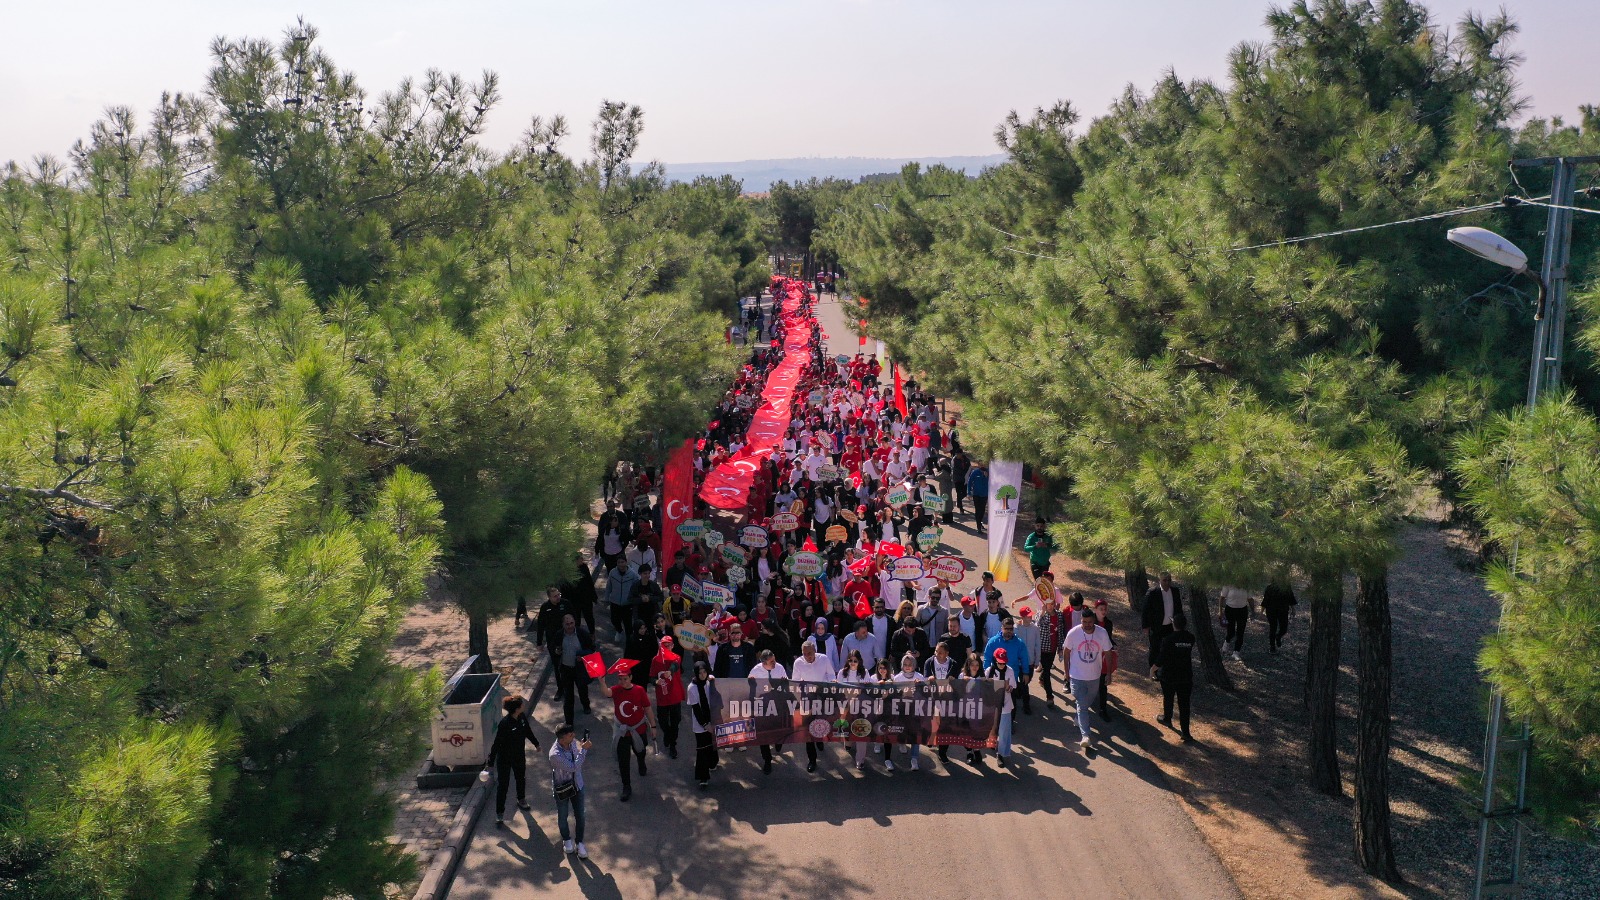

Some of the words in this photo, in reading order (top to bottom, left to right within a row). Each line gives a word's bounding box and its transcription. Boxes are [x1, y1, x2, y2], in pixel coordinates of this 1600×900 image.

[889, 494, 907, 504] SPOR
[722, 550, 743, 565] SPOR
[704, 589, 723, 597] SPORA
[680, 629, 693, 638] HER
[693, 633, 706, 642] GÜN
[789, 685, 817, 694] EKİM
[823, 686, 860, 695] DÜNYA
[866, 686, 917, 696] YÜRÜYÜŞ
[923, 684, 953, 693] GÜNÜ
[729, 696, 779, 719] DOĞA
[787, 696, 884, 718] YÜRÜYÜŞÜ
[891, 697, 983, 720] ETKİNLİĞİ
[716, 725, 734, 737] ADIM
